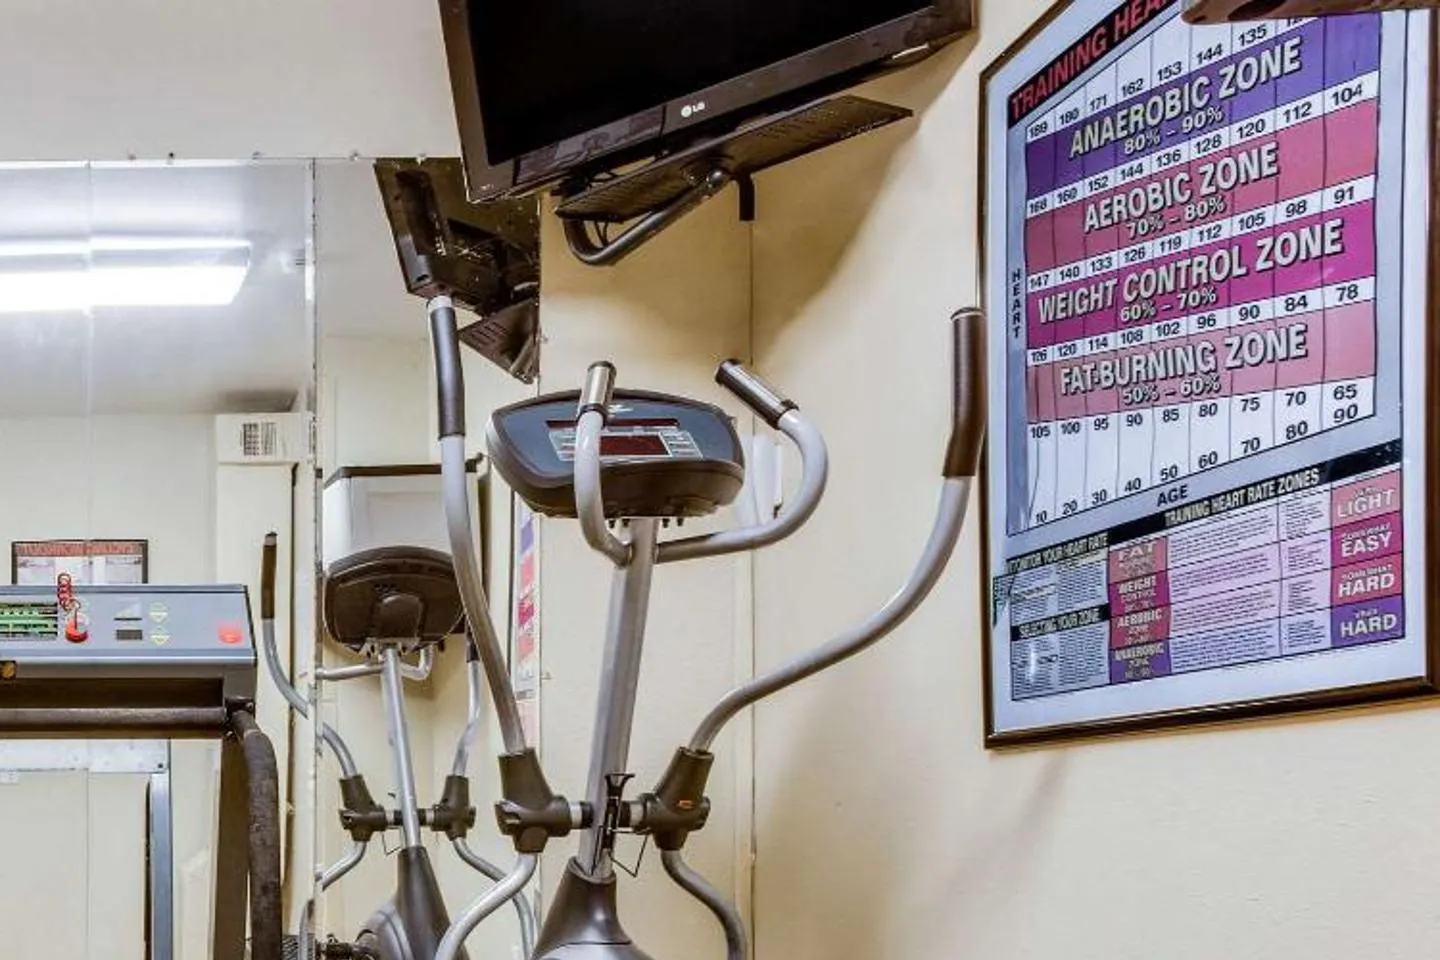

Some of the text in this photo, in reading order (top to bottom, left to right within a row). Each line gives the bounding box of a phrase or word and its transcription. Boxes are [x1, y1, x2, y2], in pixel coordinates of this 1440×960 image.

[1012, 27, 1108, 119] TRAINING
[1060, 107, 1079, 124] 180
[1090, 94, 1108, 111] 171
[1122, 78, 1144, 97] 162
[1158, 61, 1182, 81] 153
[1196, 43, 1222, 64] 144
[1239, 24, 1266, 46] 135
[1070, 36, 1303, 158] ANAEROBIC ZONE
[1089, 176, 1108, 192] 152
[1120, 163, 1144, 180] 144
[1156, 150, 1181, 167] 136
[1196, 134, 1222, 154] 128
[1236, 118, 1266, 139] 120
[1284, 103, 1312, 122] 112
[1332, 86, 1362, 105] 104
[1124, 129, 1161, 154] 80%
[1182, 106, 1224, 133] 90%
[1084, 141, 1279, 233] AEROBIC ZONE
[1030, 186, 1354, 288] 147 140 133 126 119 112 105 98 91
[1127, 218, 1164, 240] 70%
[1184, 195, 1226, 222] 80%
[1038, 218, 1344, 325] WEIGHT CONTROL ZONE
[1058, 343, 1076, 357] 120
[1088, 336, 1108, 350] 114
[1122, 330, 1144, 344] 108
[1156, 321, 1180, 336] 102
[1198, 314, 1216, 328] 96
[1239, 304, 1260, 320] 90
[1285, 295, 1308, 311] 84
[1336, 284, 1358, 300] 78
[1120, 301, 1156, 322] 60%
[1177, 286, 1217, 311] 70%
[1225, 324, 1308, 370] ZONE
[1031, 384, 1357, 438] 105 100 95 90 85 80 75 70 65
[1124, 384, 1160, 405] 50%
[1180, 376, 1222, 398] 60%
[1036, 404, 1358, 524] 10 20 30 40 50 60 70 80 90
[1157, 484, 1189, 506] AGE
[1164, 468, 1320, 527] TRAINING HEART RATE ZONES
[1337, 489, 1394, 517] LIGHT
[1341, 531, 1392, 557] EASY
[1339, 573, 1395, 598] HARD
[1340, 614, 1397, 638] HARD
